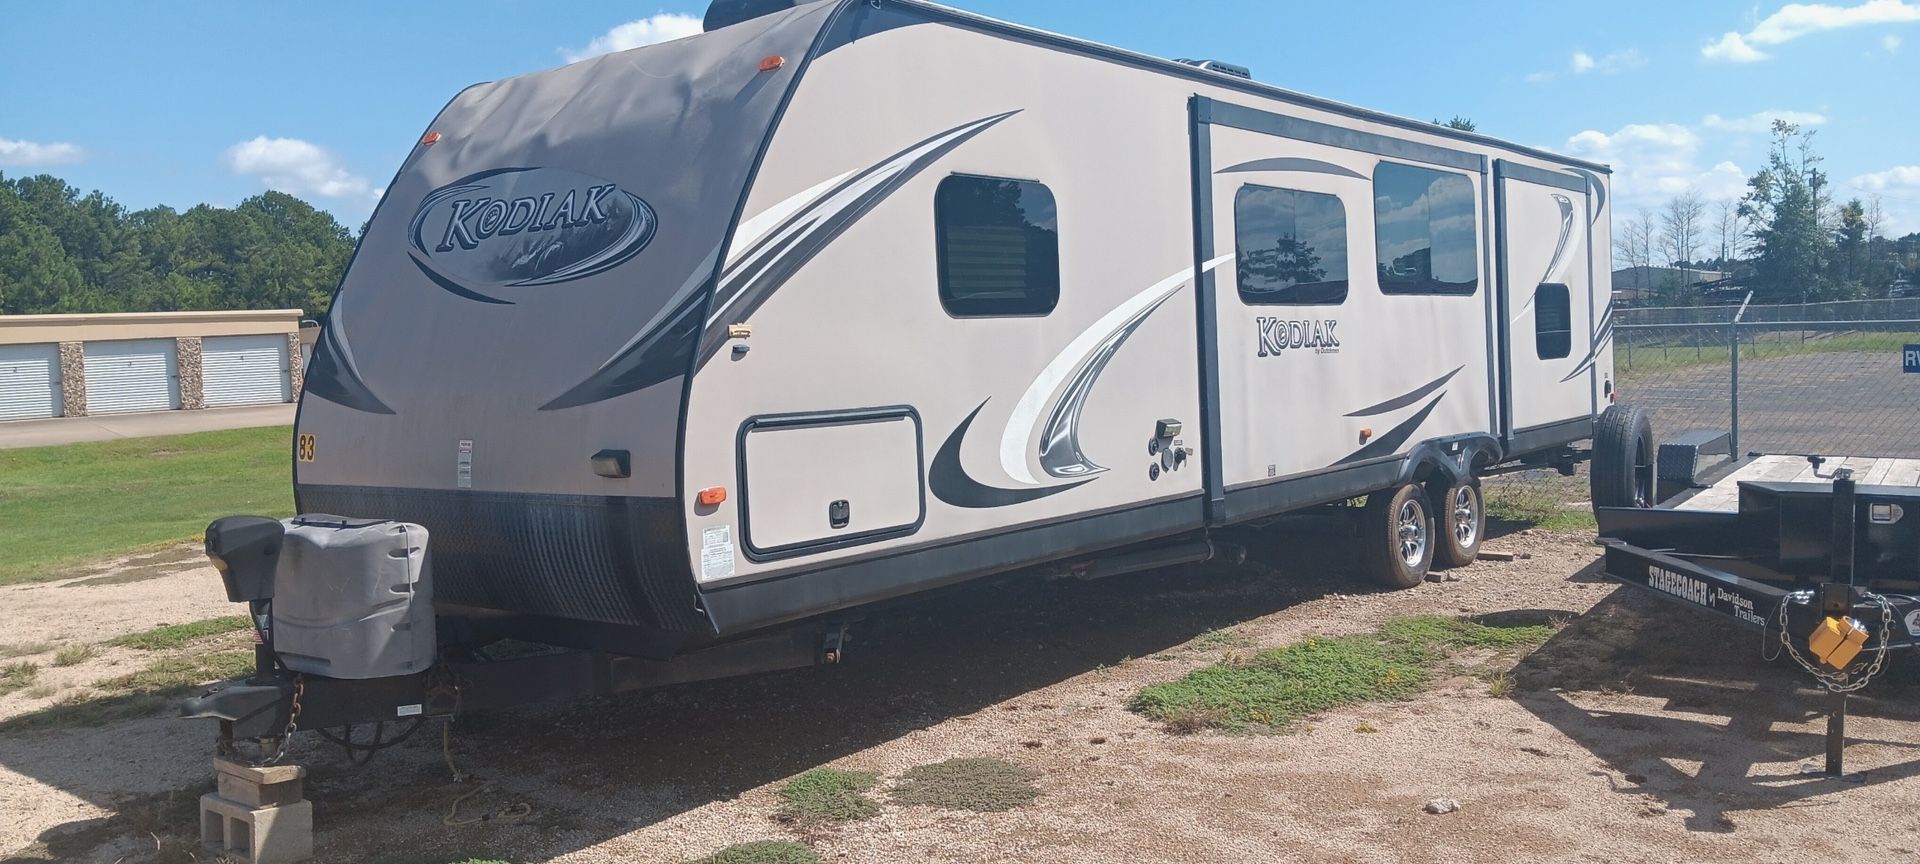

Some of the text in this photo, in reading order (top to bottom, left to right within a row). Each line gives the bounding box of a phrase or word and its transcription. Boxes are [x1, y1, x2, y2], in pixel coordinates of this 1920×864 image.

[435, 183, 616, 252] KODIAK
[1256, 317, 1340, 357] KODIAK
[299, 435, 315, 461] 83
[1648, 565, 1707, 606] STAGECOACH
[1717, 587, 1754, 610] Davidson
[1733, 605, 1766, 627] Trailers
